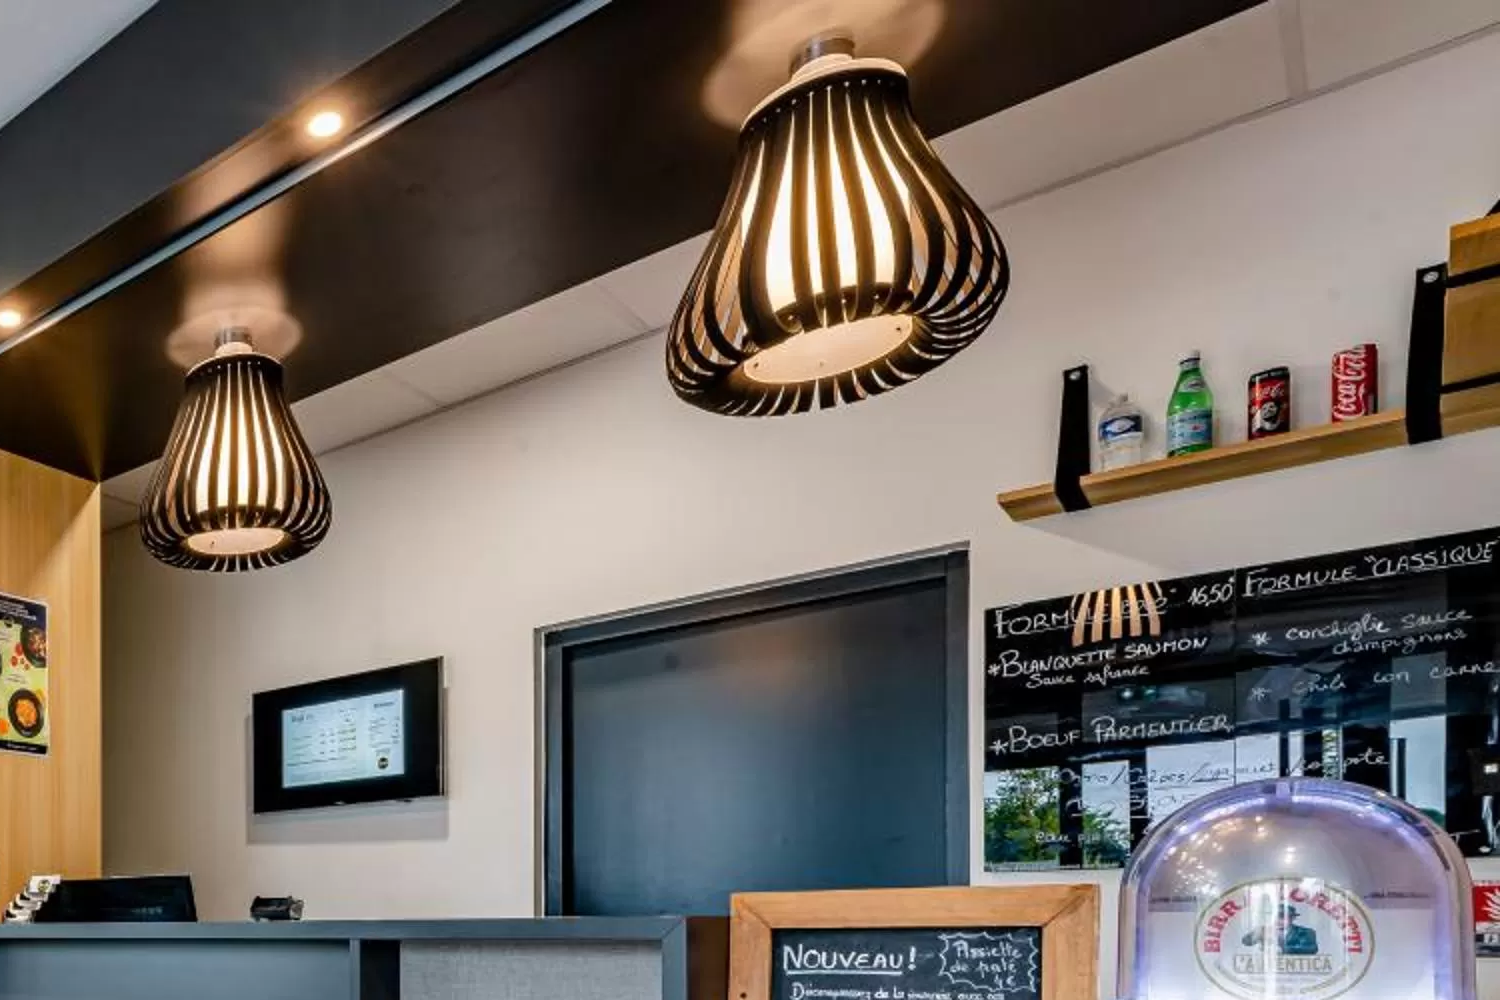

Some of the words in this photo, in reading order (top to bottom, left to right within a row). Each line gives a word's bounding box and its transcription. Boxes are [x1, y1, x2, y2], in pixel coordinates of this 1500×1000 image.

[1243, 567, 1357, 597] FORMULE
[1001, 649, 1116, 678] BLANQUETTE
[1124, 637, 1209, 659] SAUMON
[1008, 725, 1080, 752] BOEUF
[1090, 713, 1235, 743] PARMENTIER
[1204, 893, 1248, 953] BIRR
[783, 943, 903, 971] NOUVEAU
